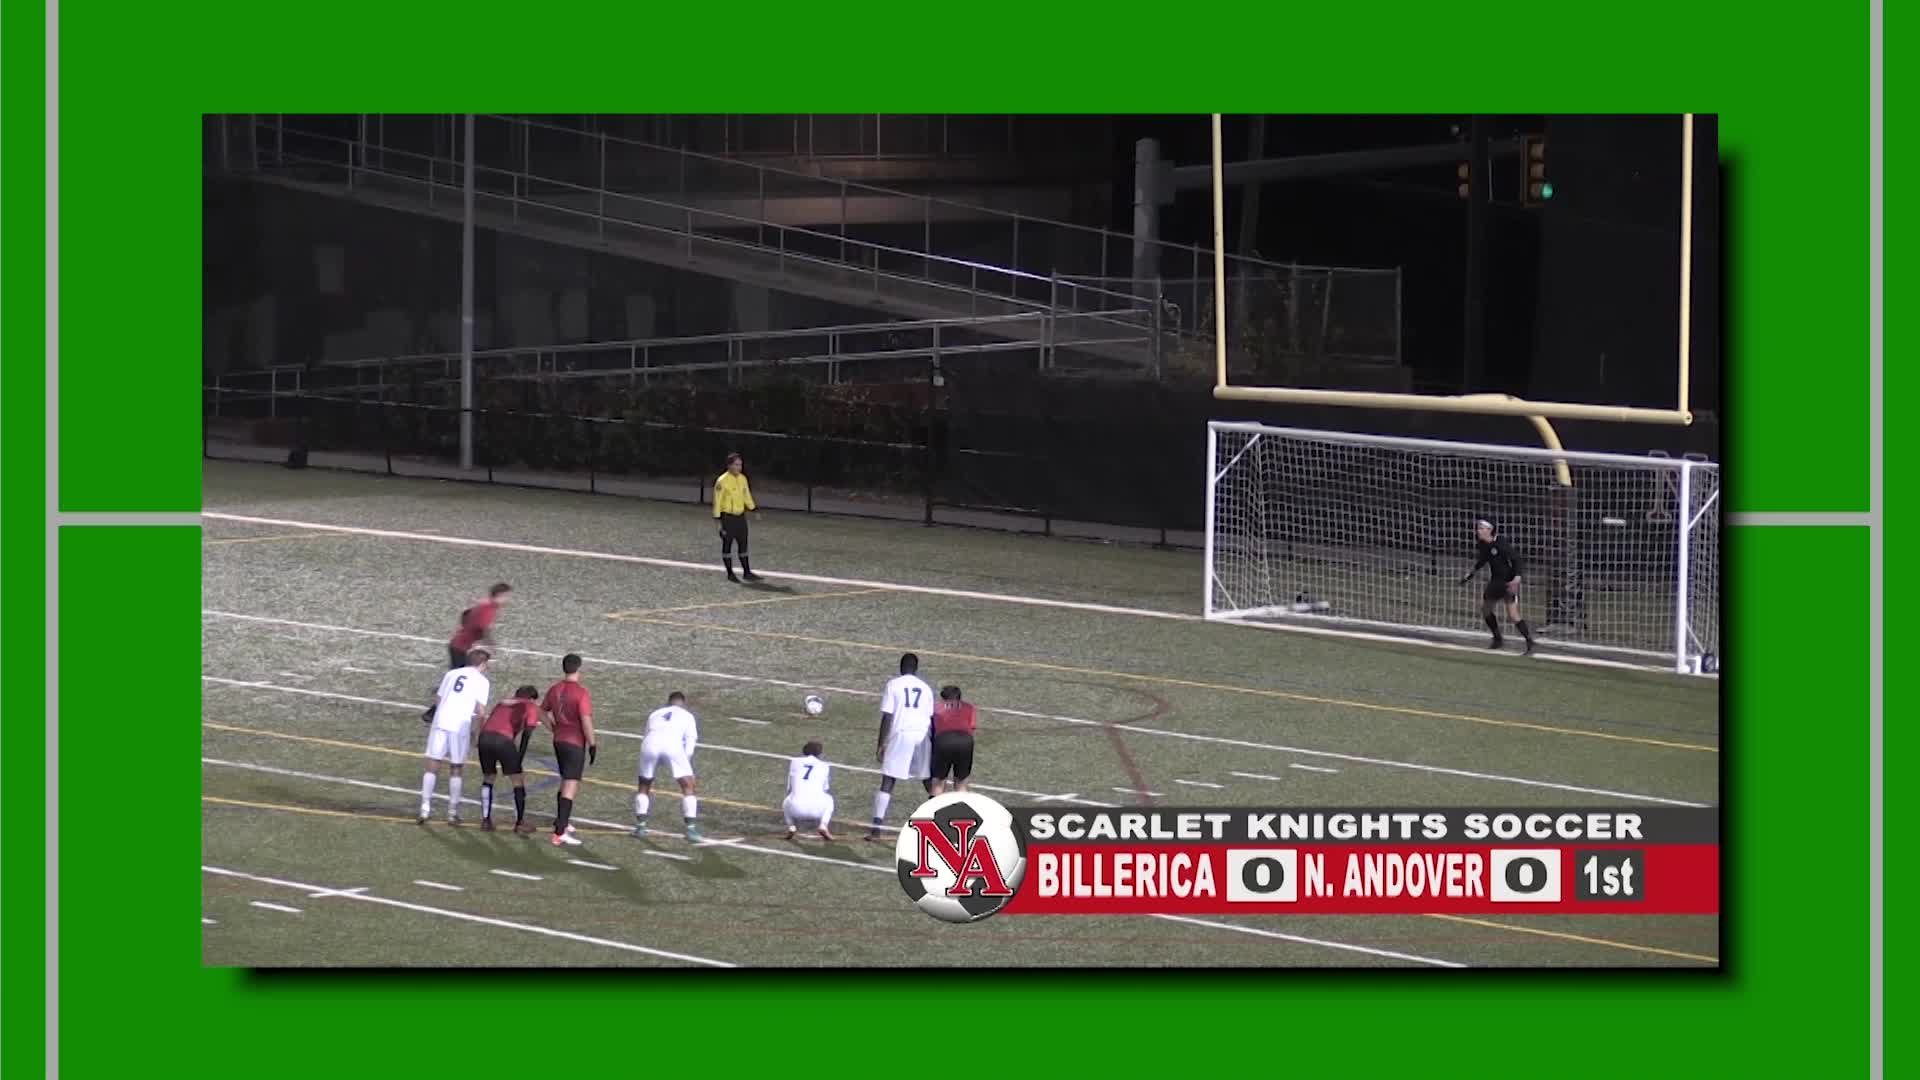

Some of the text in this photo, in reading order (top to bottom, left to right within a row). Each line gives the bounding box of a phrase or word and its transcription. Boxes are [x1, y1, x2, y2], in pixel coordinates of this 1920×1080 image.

[453, 675, 467, 693] 6
[903, 687, 922, 709] 17
[660, 711, 673, 722] 4
[802, 765, 814, 780] 7
